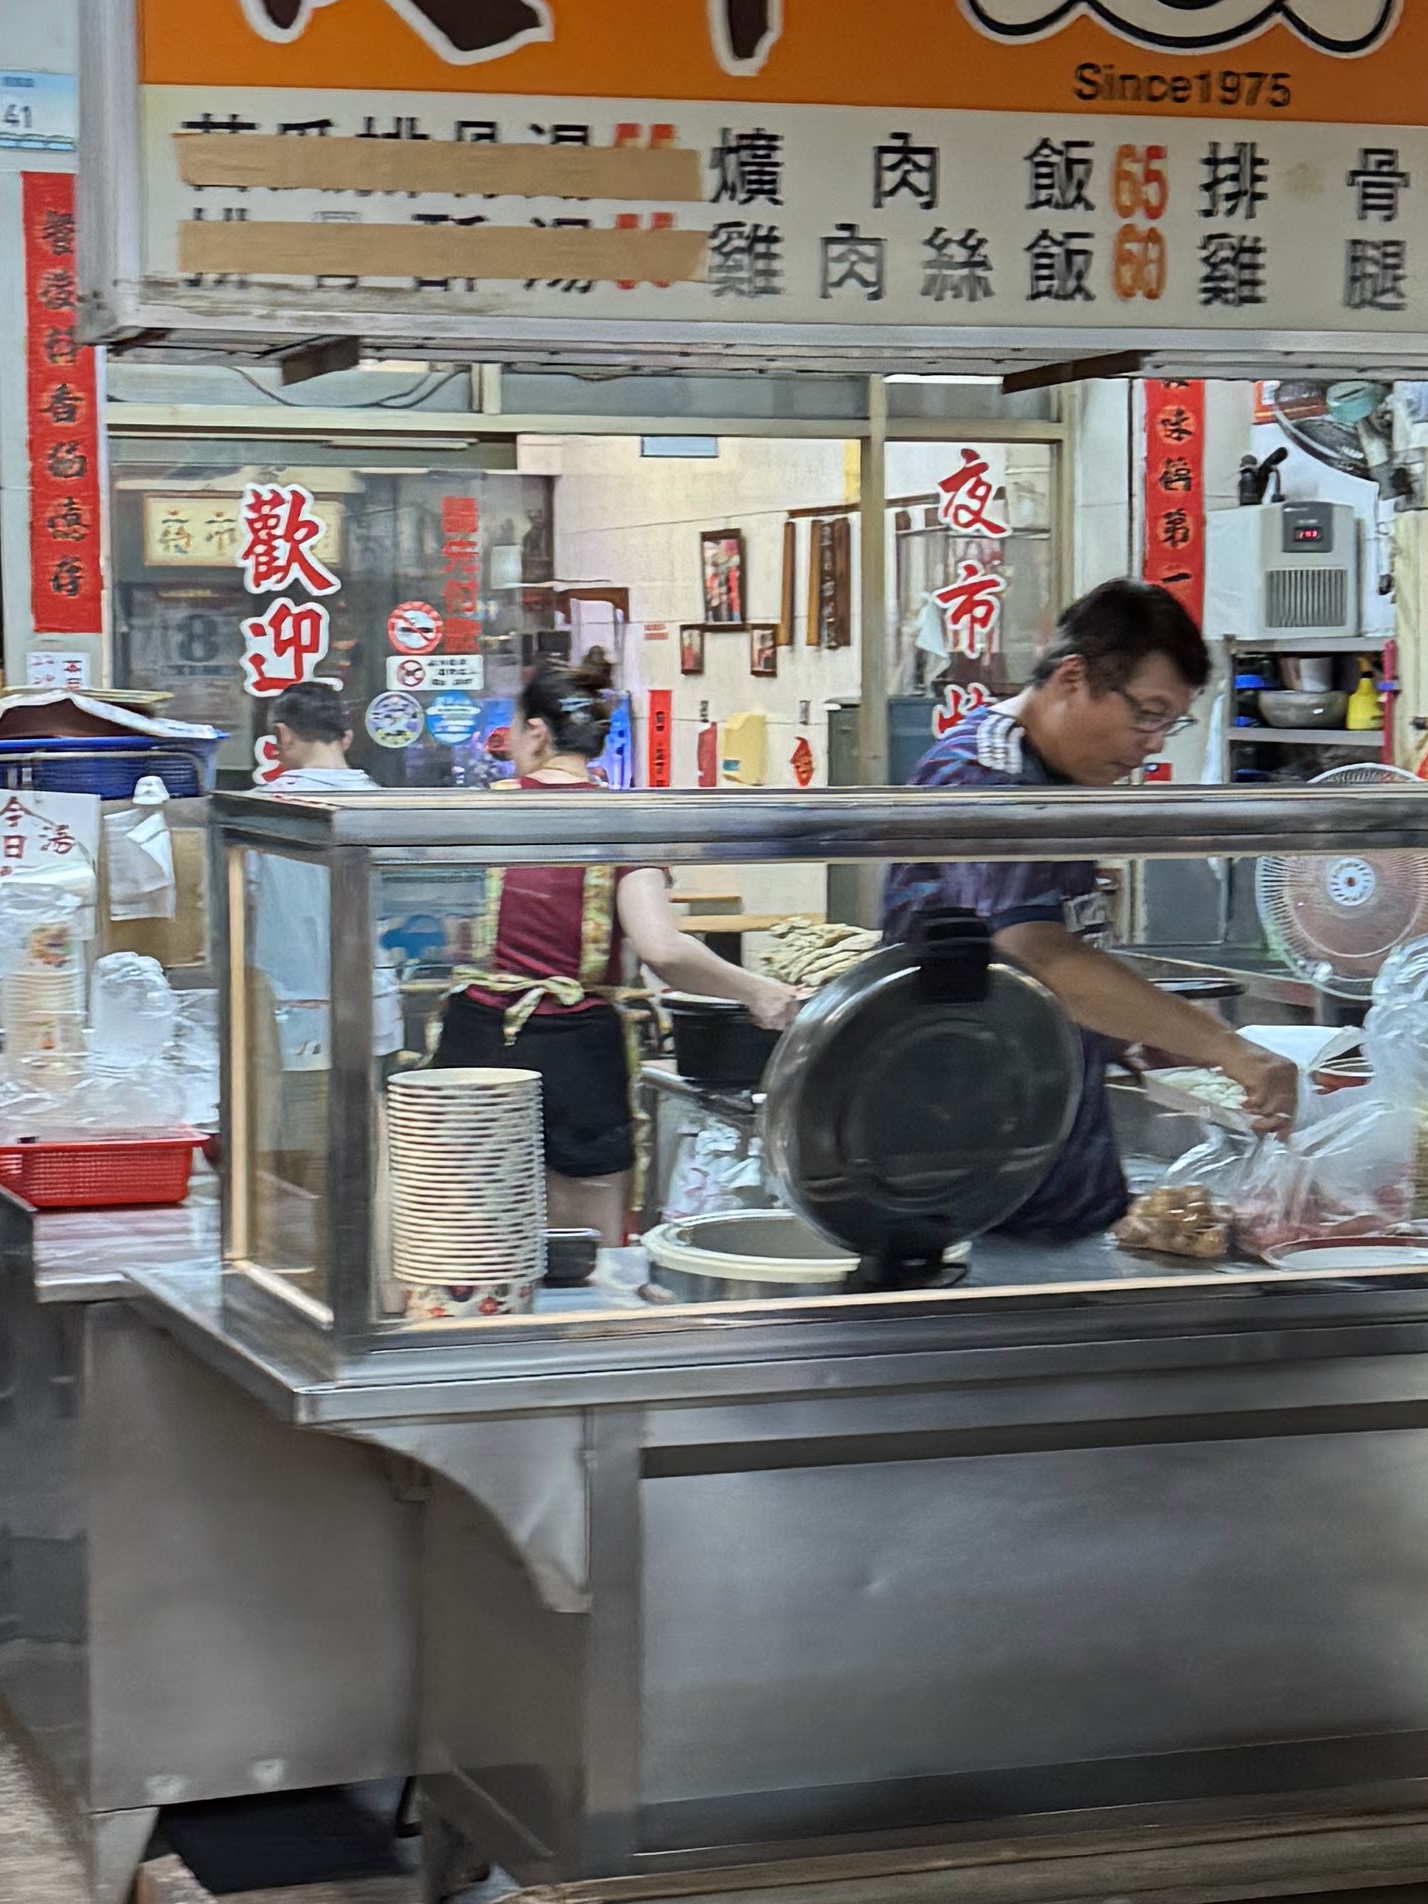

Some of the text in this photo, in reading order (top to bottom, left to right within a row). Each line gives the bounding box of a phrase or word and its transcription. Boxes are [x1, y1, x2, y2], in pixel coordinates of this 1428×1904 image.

[3, 103, 33, 128] 41
[1074, 62, 1292, 107] Since1975
[1113, 143, 1169, 221] 65
[709, 220, 1096, 303] 雞肉絲飯
[238, 484, 342, 786] 歡迎
